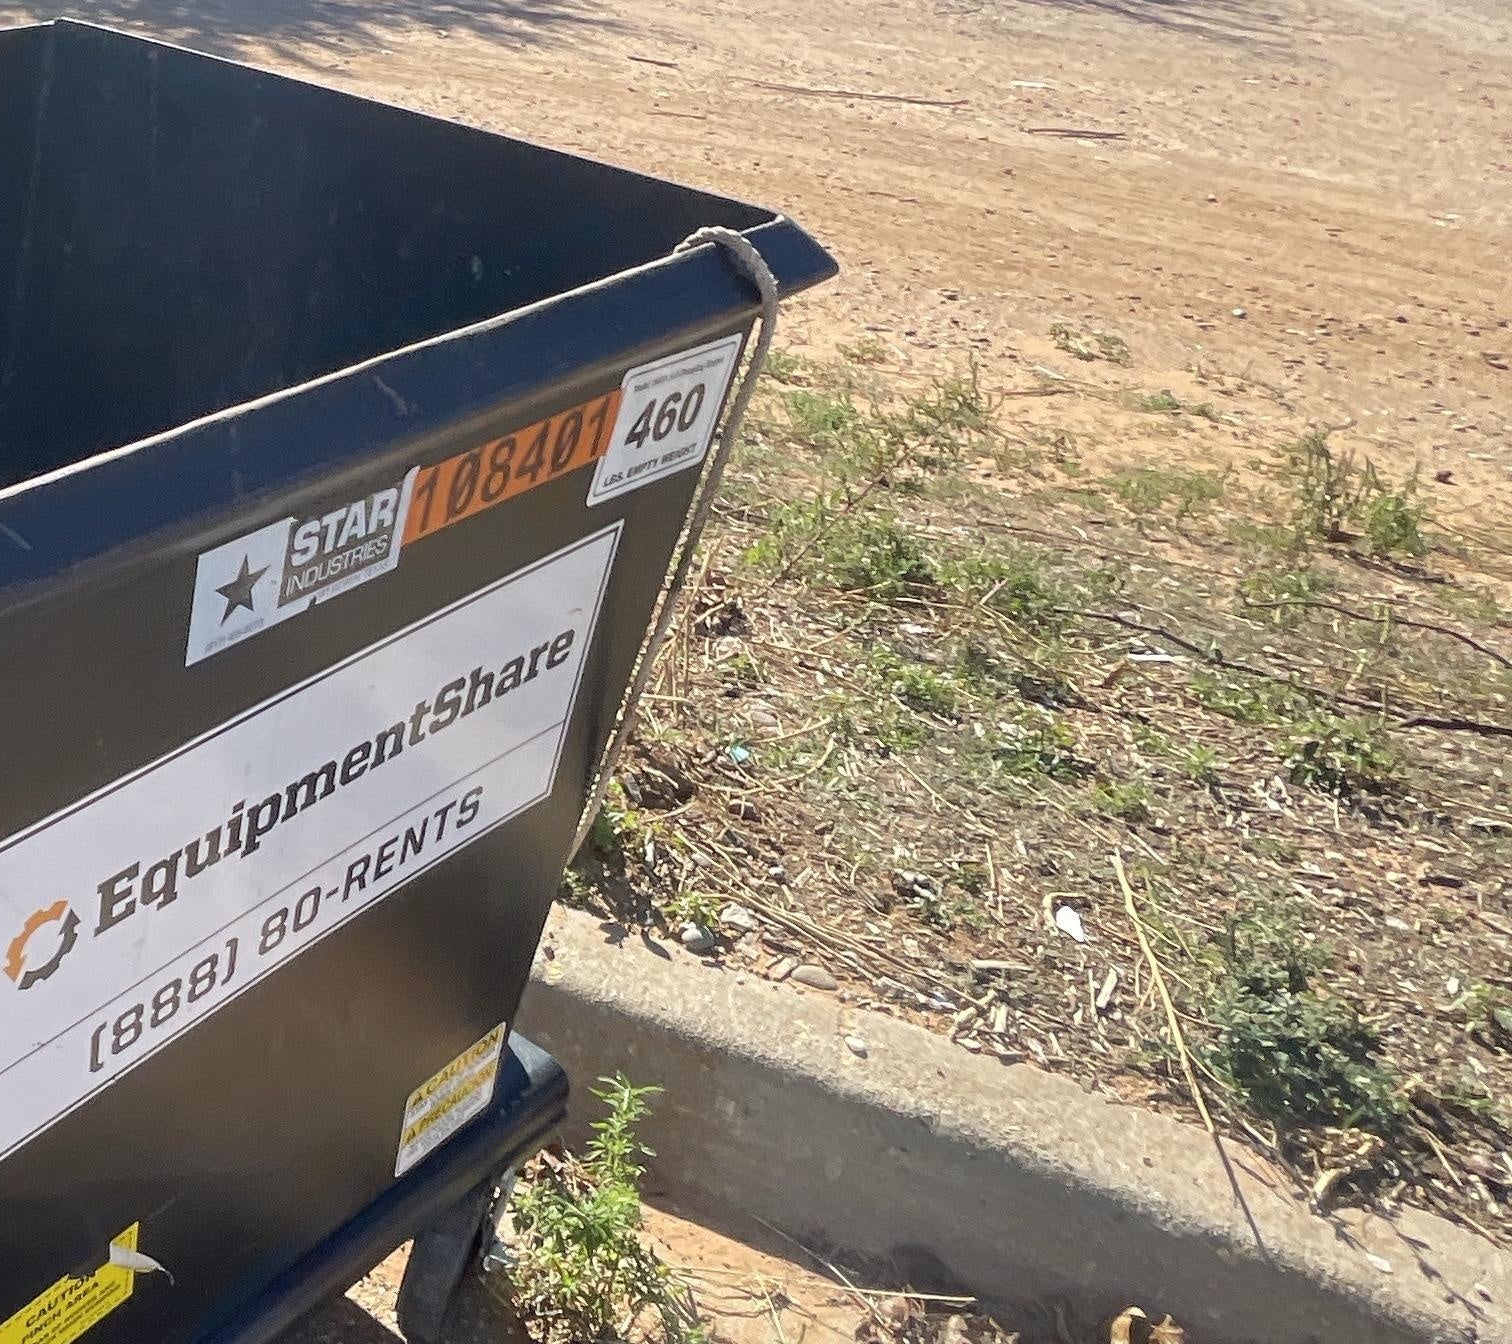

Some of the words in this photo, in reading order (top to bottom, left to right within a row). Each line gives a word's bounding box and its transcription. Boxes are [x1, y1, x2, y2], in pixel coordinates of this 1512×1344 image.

[624, 383, 706, 449] 460
[417, 395, 610, 536] 108401
[627, 458, 659, 478] EMPTY
[291, 488, 399, 566] STAR
[285, 534, 390, 597] INDUSTRIES
[93, 627, 576, 936] EquipmentShare
[258, 786, 485, 957] 80-RENTS
[427, 1030, 499, 1094] CAUTION
[20, 1313, 63, 1344] PINCH
[65, 1281, 100, 1312] AREA
